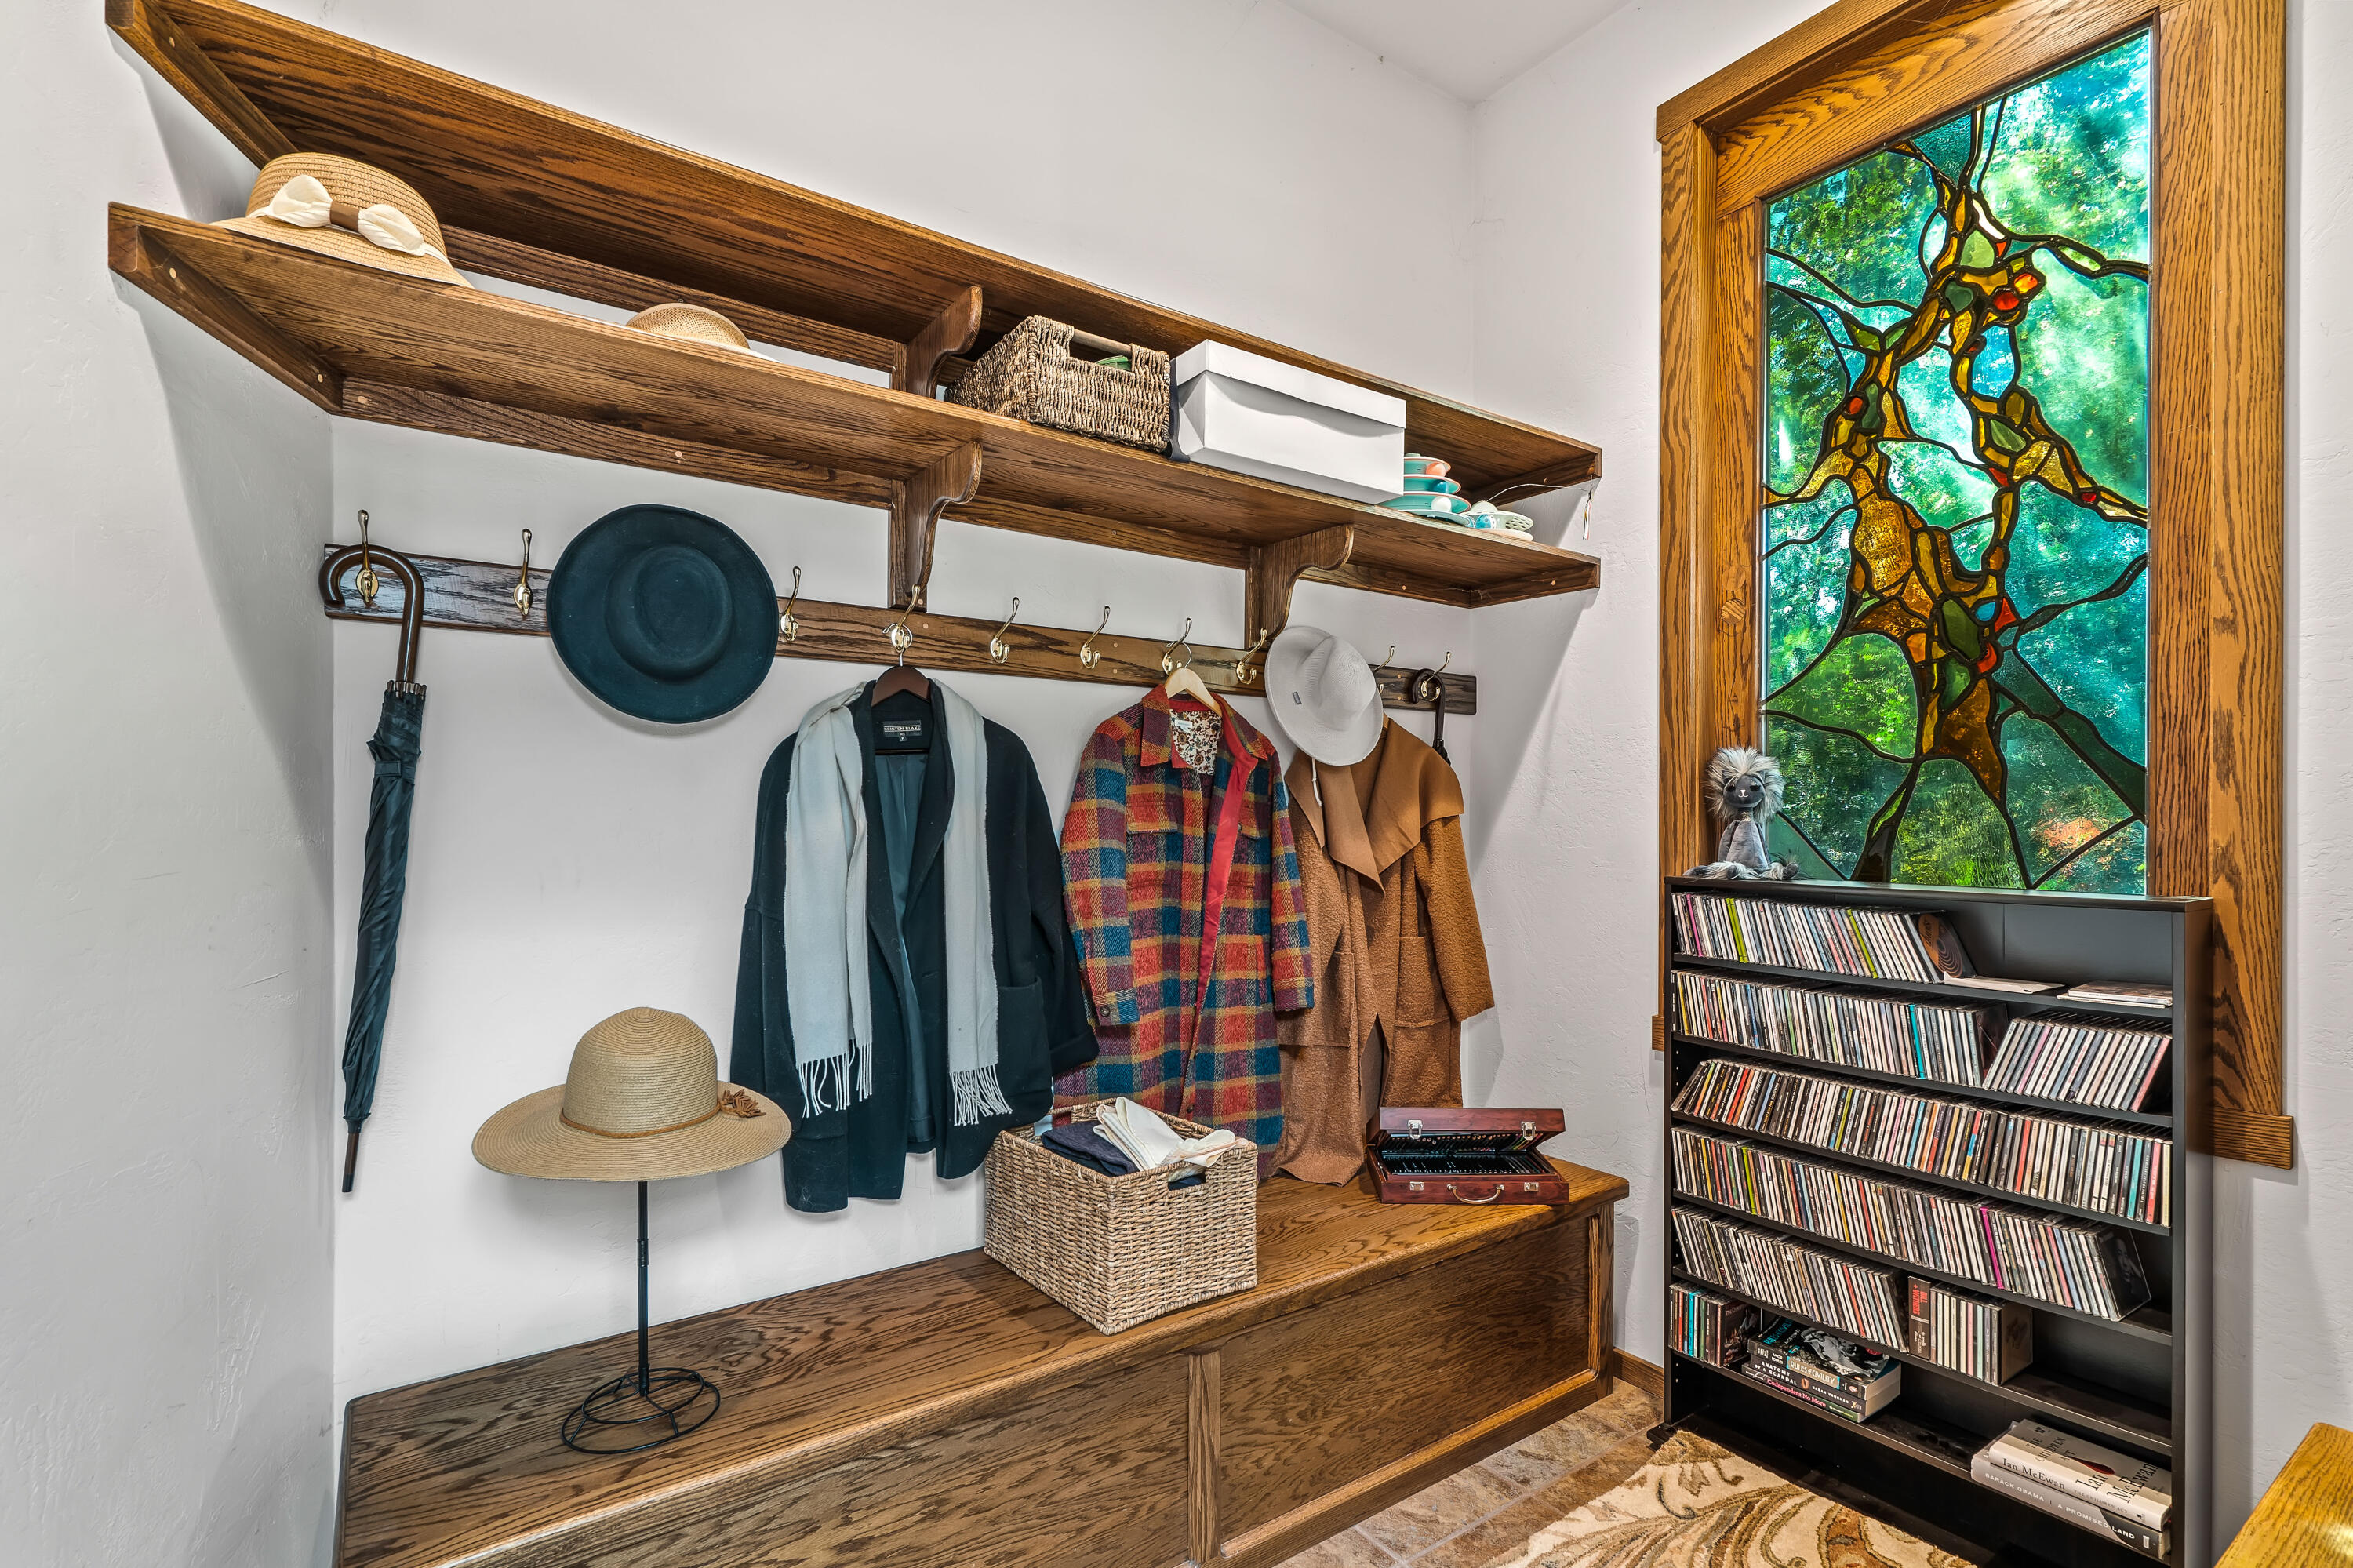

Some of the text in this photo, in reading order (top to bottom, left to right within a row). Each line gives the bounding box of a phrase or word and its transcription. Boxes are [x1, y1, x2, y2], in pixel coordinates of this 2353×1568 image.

[1761, 1361, 1790, 1376] ANATOMY
[1769, 1370, 1797, 1385] SCANDAL
[1790, 1361, 1807, 1373] RULES
[1812, 1370, 1835, 1384] CIVILITY
[1767, 1377, 1801, 1397] Codependent
[1811, 1397, 1826, 1407] More
[1812, 1385, 1849, 1404] SARAH VAUGHAN
[2025, 1437, 2042, 1449] THE
[2035, 1437, 2066, 1462] CHILDREN
[2002, 1458, 2065, 1489] Ian McEwan
[2075, 1474, 2108, 1491] Ian
[2107, 1464, 2159, 1503] McEwan
[1985, 1473, 2045, 1502] BARACK OBAMA
[2087, 1494, 2117, 1509] CHILDREN
[2065, 1507, 2108, 1528] PROMISED
[2112, 1526, 2135, 1539] LAND
